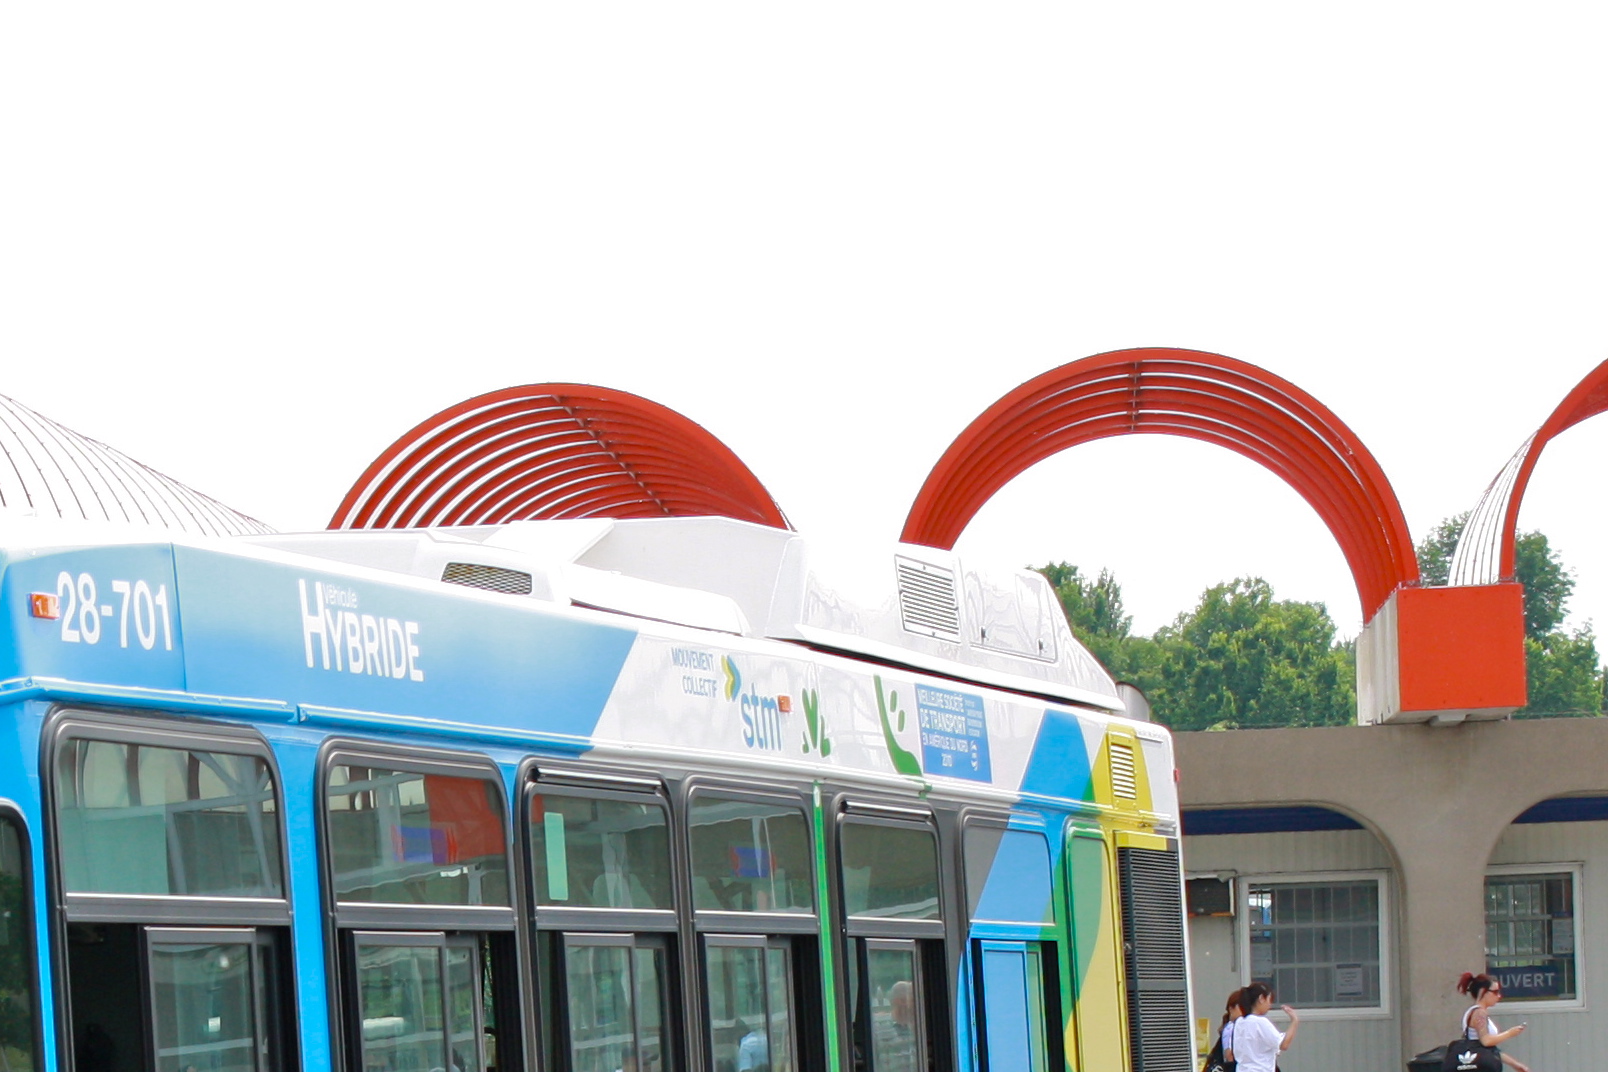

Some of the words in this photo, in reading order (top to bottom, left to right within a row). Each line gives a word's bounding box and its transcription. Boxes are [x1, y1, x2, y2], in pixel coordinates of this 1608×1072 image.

[56, 570, 173, 651] 28-701
[298, 578, 424, 682] HYBRIDE
[671, 647, 714, 671] MOUVEMENT
[682, 675, 718, 698] COLLECTIF
[741, 682, 781, 751] stm
[1495, 972, 1555, 988] UVERT
